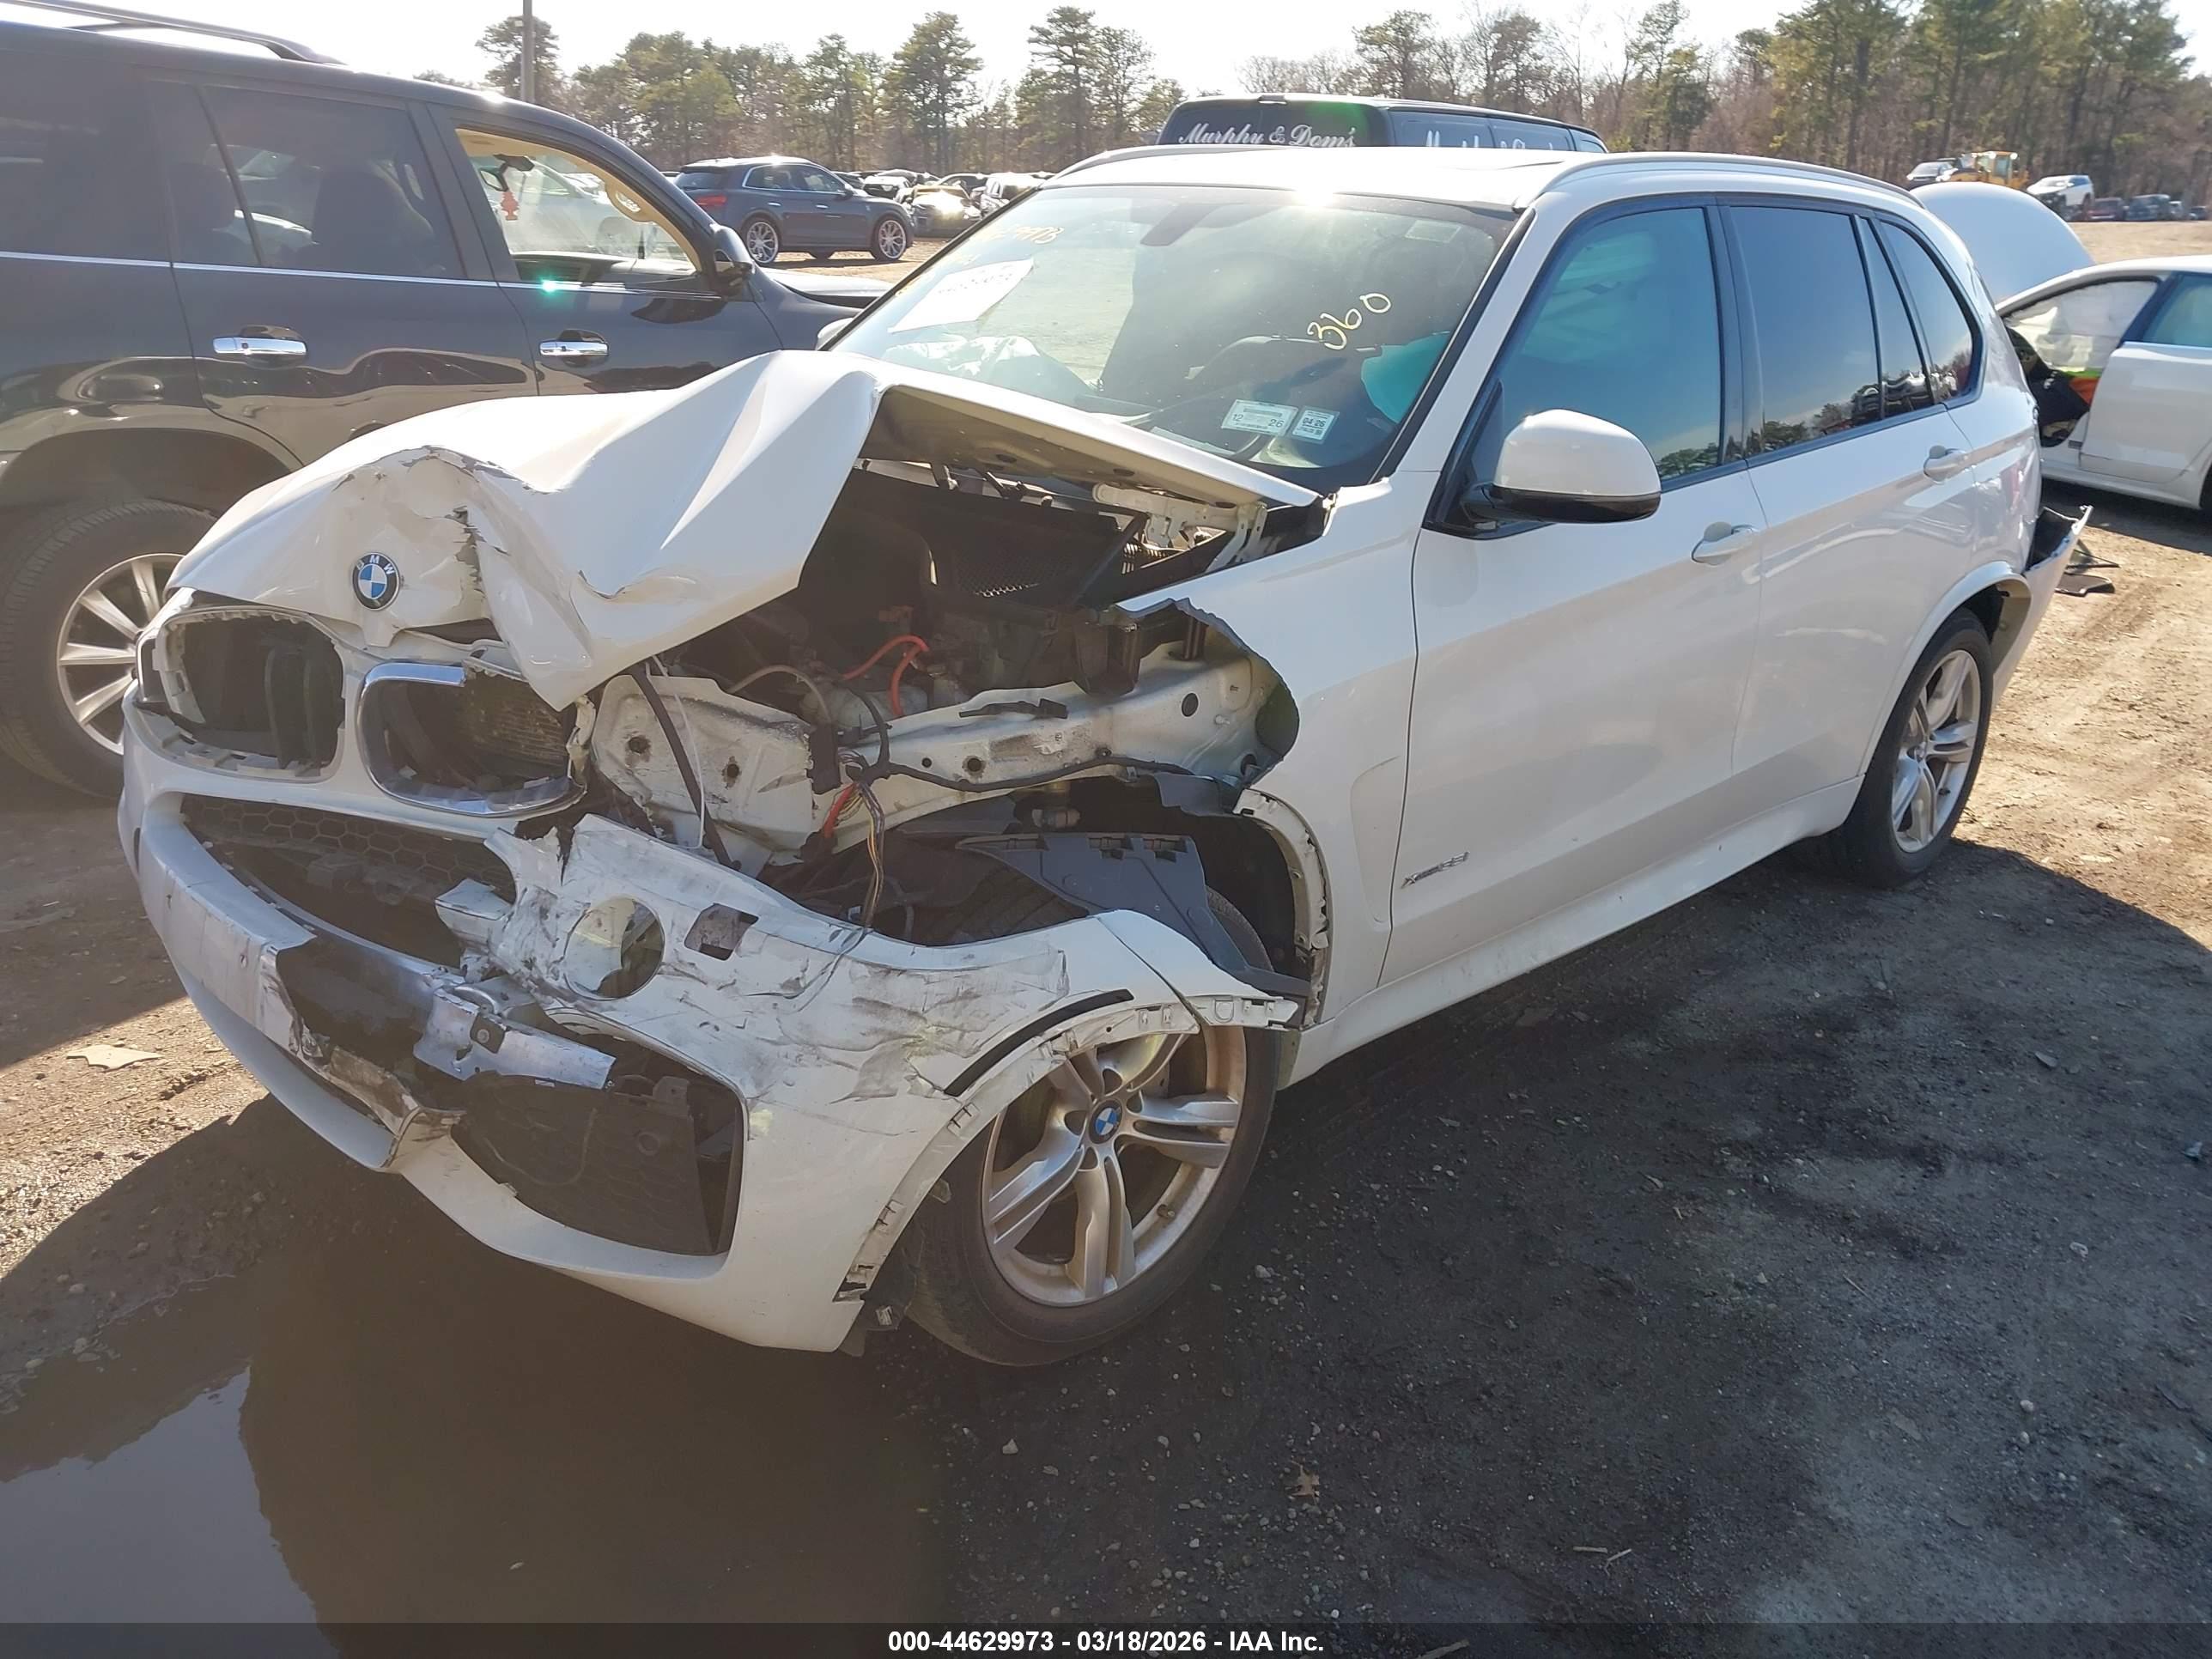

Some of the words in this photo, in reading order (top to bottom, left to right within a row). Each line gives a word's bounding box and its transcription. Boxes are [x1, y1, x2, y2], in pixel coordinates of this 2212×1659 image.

[1268, 125, 1286, 144] &
[1307, 293, 1392, 350] 360
[1268, 418, 1284, 428] 26
[356, 554, 395, 574] BMW
